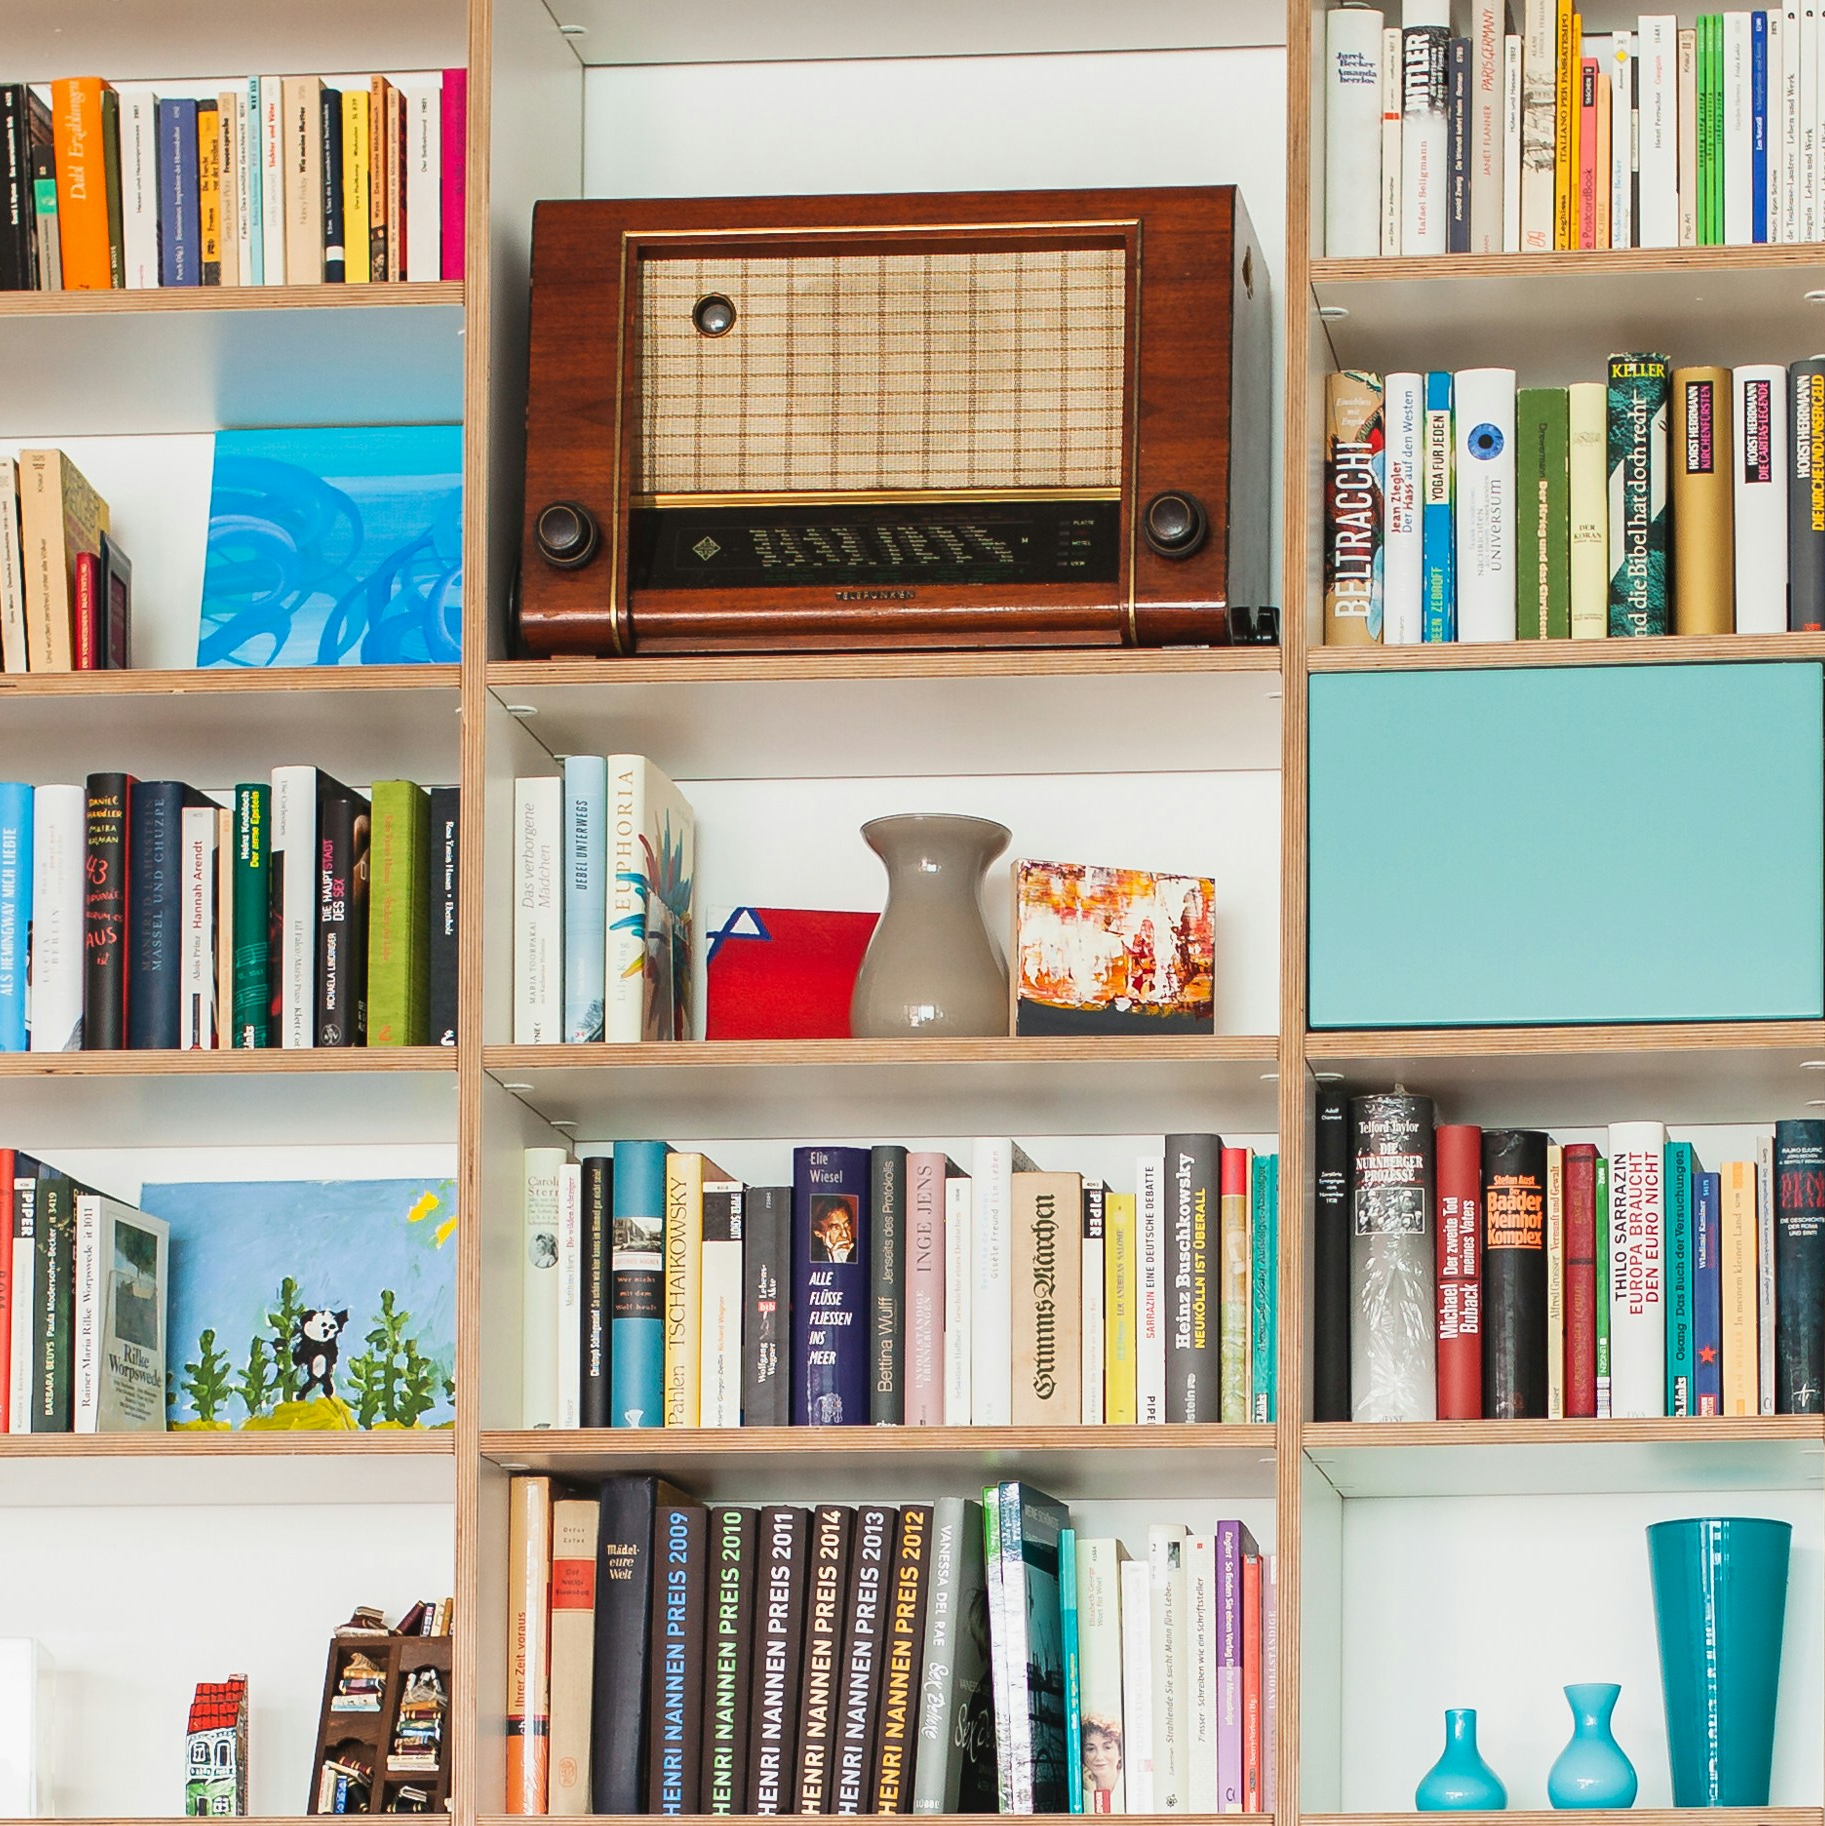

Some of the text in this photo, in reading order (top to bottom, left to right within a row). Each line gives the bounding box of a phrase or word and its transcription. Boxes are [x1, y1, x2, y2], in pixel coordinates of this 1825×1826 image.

[1405, 34, 1429, 110] HITLER
[1417, 141, 1429, 235] Rafael Seligmann
[1402, 390, 1414, 533] Der Hass auf den Westen
[1688, 386, 1699, 469] HORST HERRMANN
[1699, 385, 1711, 468] KIRCHENFÜRSTEN
[1335, 441, 1373, 617] BELTRACCHI
[1391, 462, 1404, 533] Jean Ziegler
[1628, 392, 1648, 608] die Bibel hat doch recht
[192, 841, 203, 929] Hannah Arendt
[521, 803, 537, 908] Das verborgene
[537, 845, 551, 908] Mädchen
[575, 800, 589, 890] UEBEL UNTERWEGS
[615, 770, 633, 910] EUPHORIA
[916, 1166, 931, 1272] INGE JENS
[1487, 1192, 1542, 1210] Baader
[1488, 1211, 1543, 1228] Meinhof
[1488, 1231, 1541, 1245] Komplex
[1615, 1153, 1627, 1301] THILO SARRAZIN
[1630, 1152, 1643, 1315] EUROPA BRAUCHT
[1644, 1152, 1659, 1303] DEN EURO NICHT
[82, 1245, 95, 1302] Worpswede
[1175, 1153, 1194, 1348] Heinz Buschkowsky
[1192, 1188, 1206, 1348] NEUKÖLLN IST ÜBERALL
[81, 1308, 93, 1334] Rilke
[668, 1177, 687, 1425] Pahlen TSCHAIKOWSKY
[1440, 1284, 1459, 1339] Michael
[1460, 1284, 1478, 1334] Buback
[80, 1373, 93, 1406] Rainer
[81, 1339, 93, 1367] Maria
[713, 1512, 741, 1816] HENRI NANNEN PREIS 2010
[878, 1511, 924, 1816] HENRI NANNEN PREIS 2012
